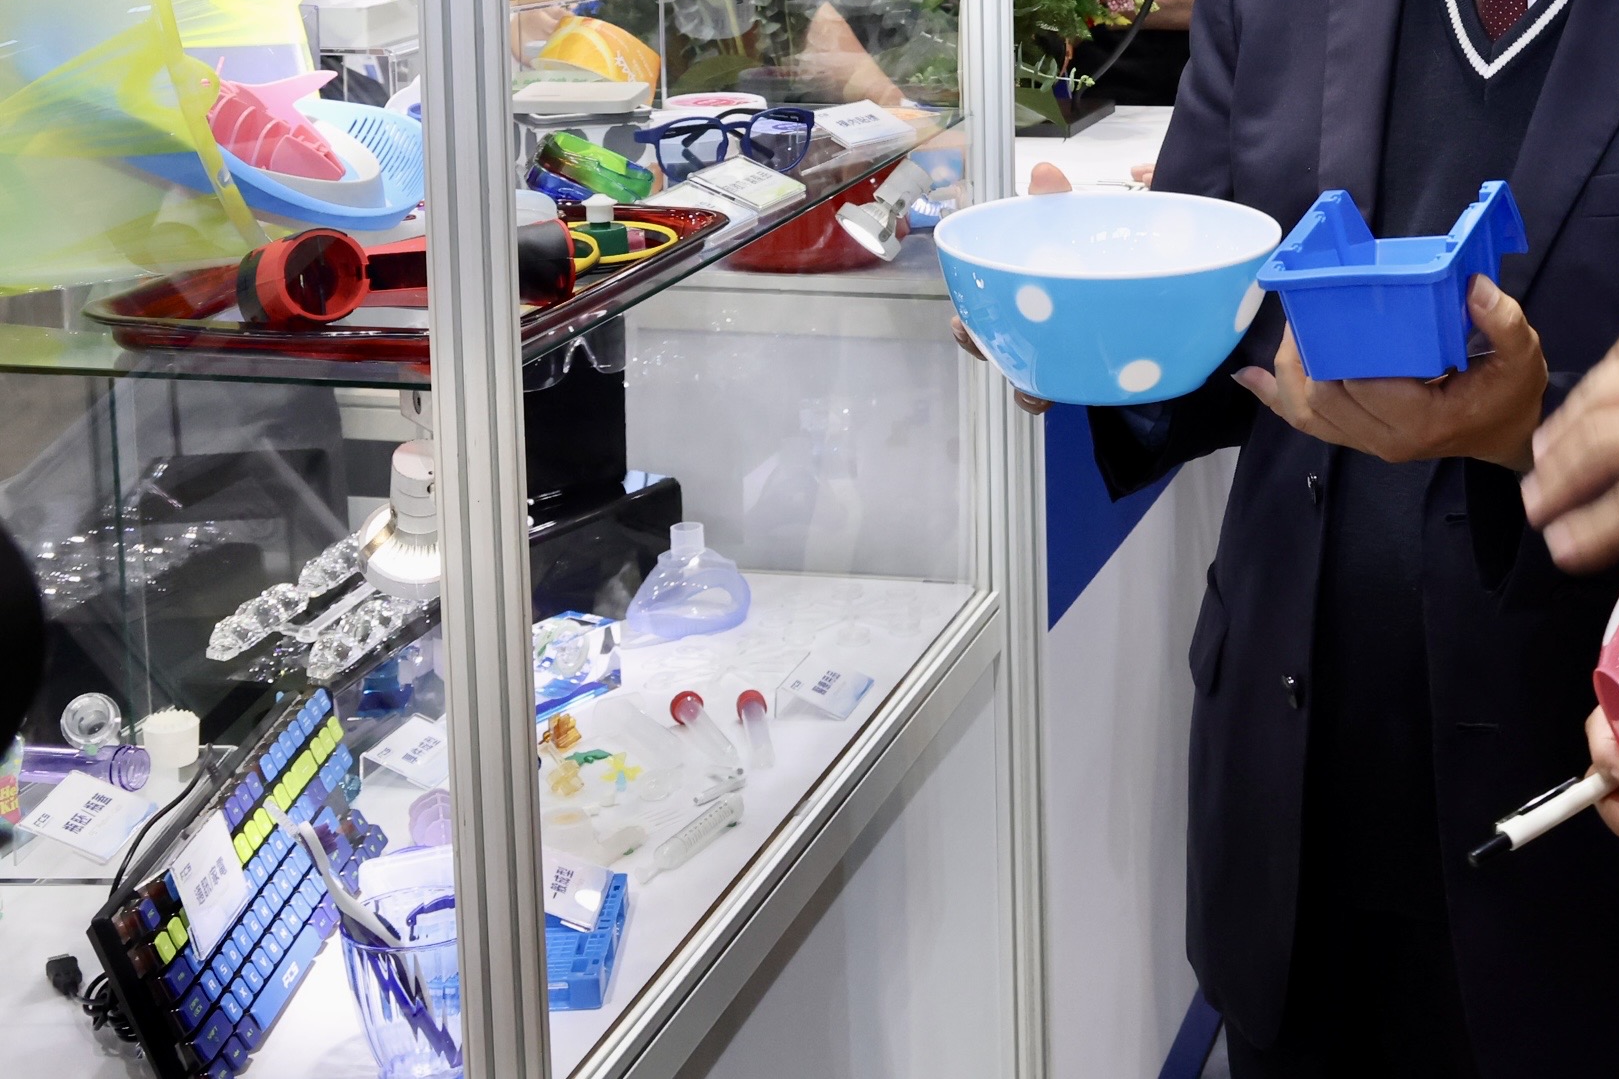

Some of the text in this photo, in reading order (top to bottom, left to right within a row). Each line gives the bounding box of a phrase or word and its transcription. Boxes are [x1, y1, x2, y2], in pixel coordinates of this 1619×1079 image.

[33, 812, 51, 828] FCS
[550, 866, 575, 900] 一般成型
